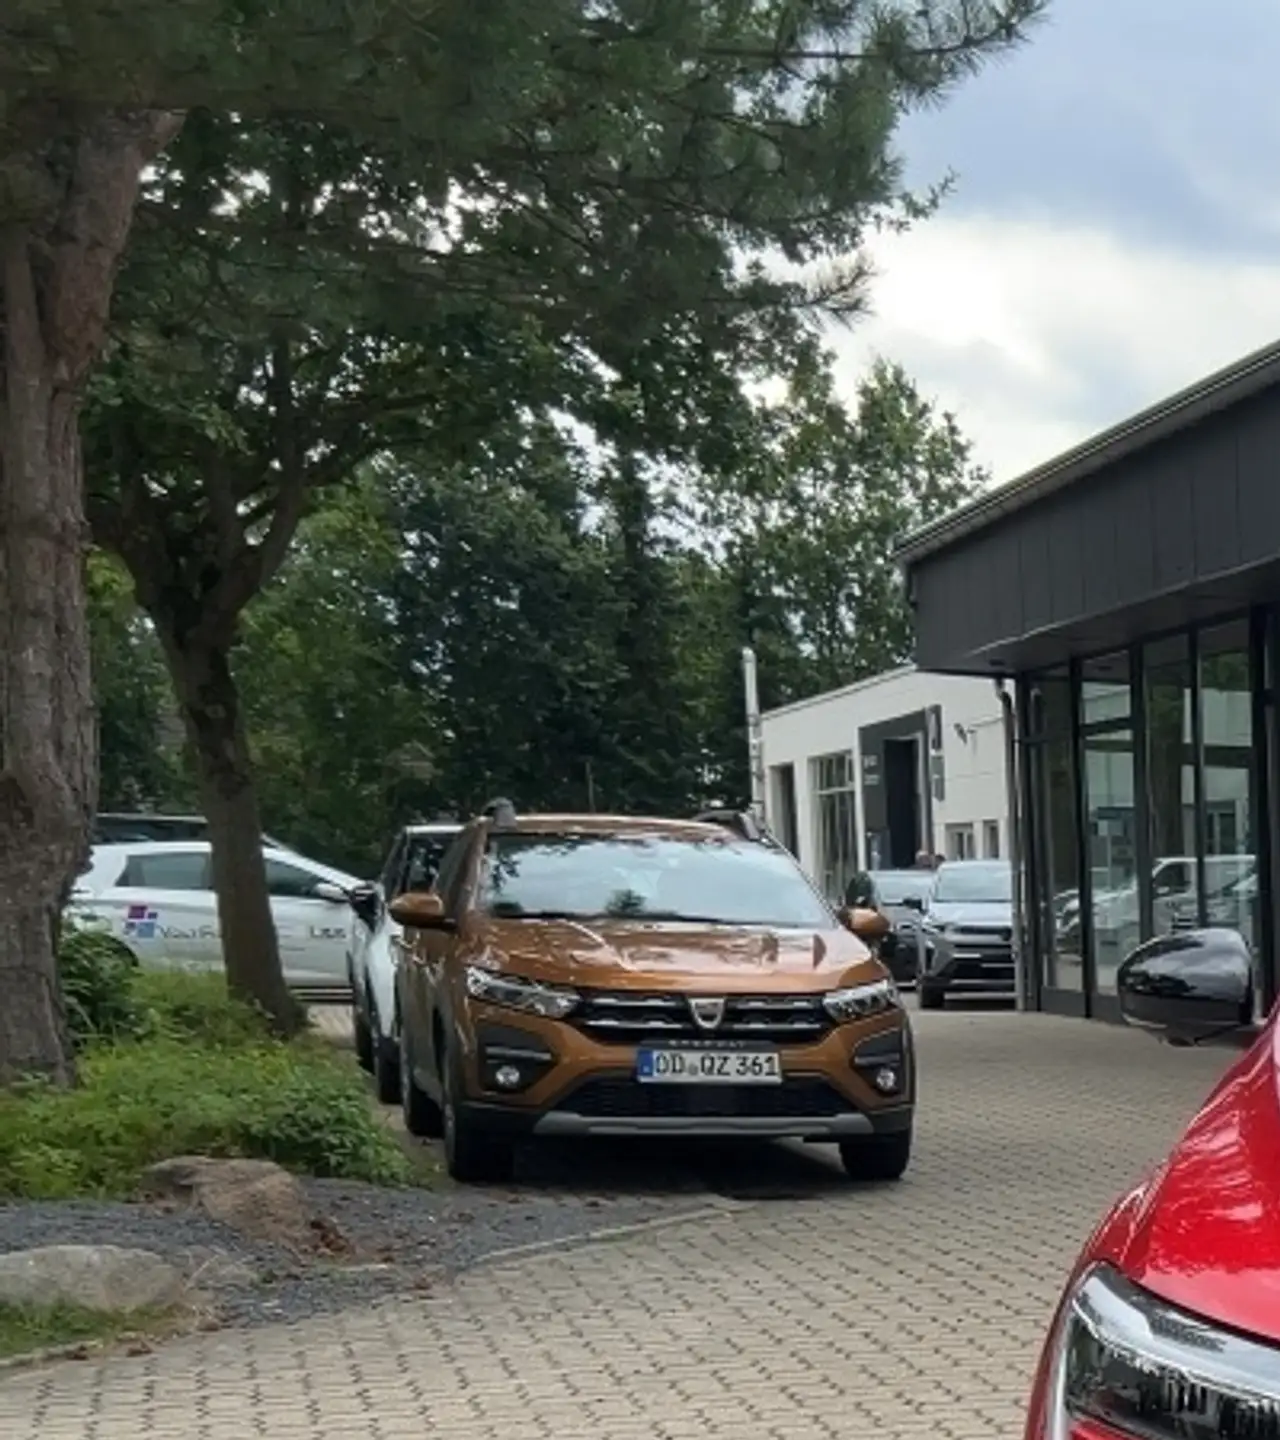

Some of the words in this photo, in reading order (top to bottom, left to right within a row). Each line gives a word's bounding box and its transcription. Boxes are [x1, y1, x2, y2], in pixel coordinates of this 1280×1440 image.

[655, 1053, 686, 1075] OD
[700, 1053, 731, 1076] QZ
[736, 1055, 778, 1077] 361
